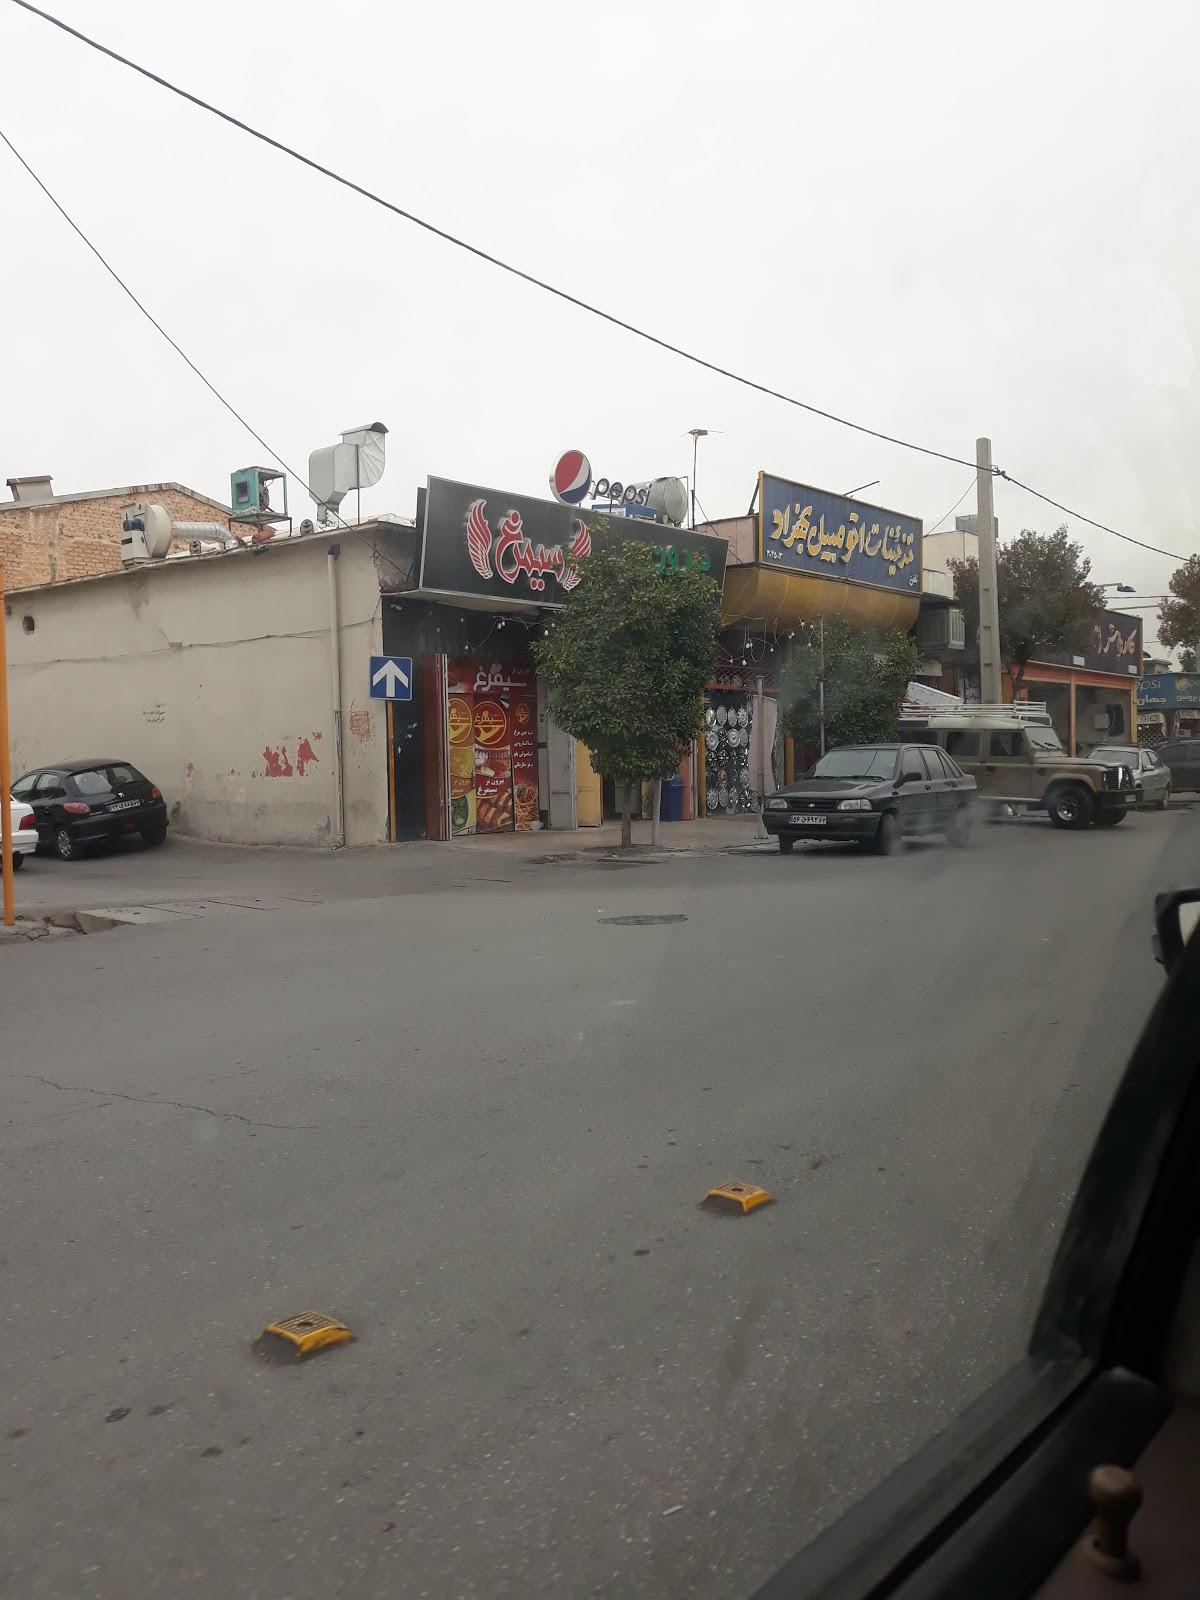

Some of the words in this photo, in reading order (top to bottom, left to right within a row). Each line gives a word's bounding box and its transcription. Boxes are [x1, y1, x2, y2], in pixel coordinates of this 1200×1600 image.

[495, 509, 568, 591] سیمرغ
[808, 512, 866, 564] اتومبیل
[866, 523, 914, 576] تزئینات
